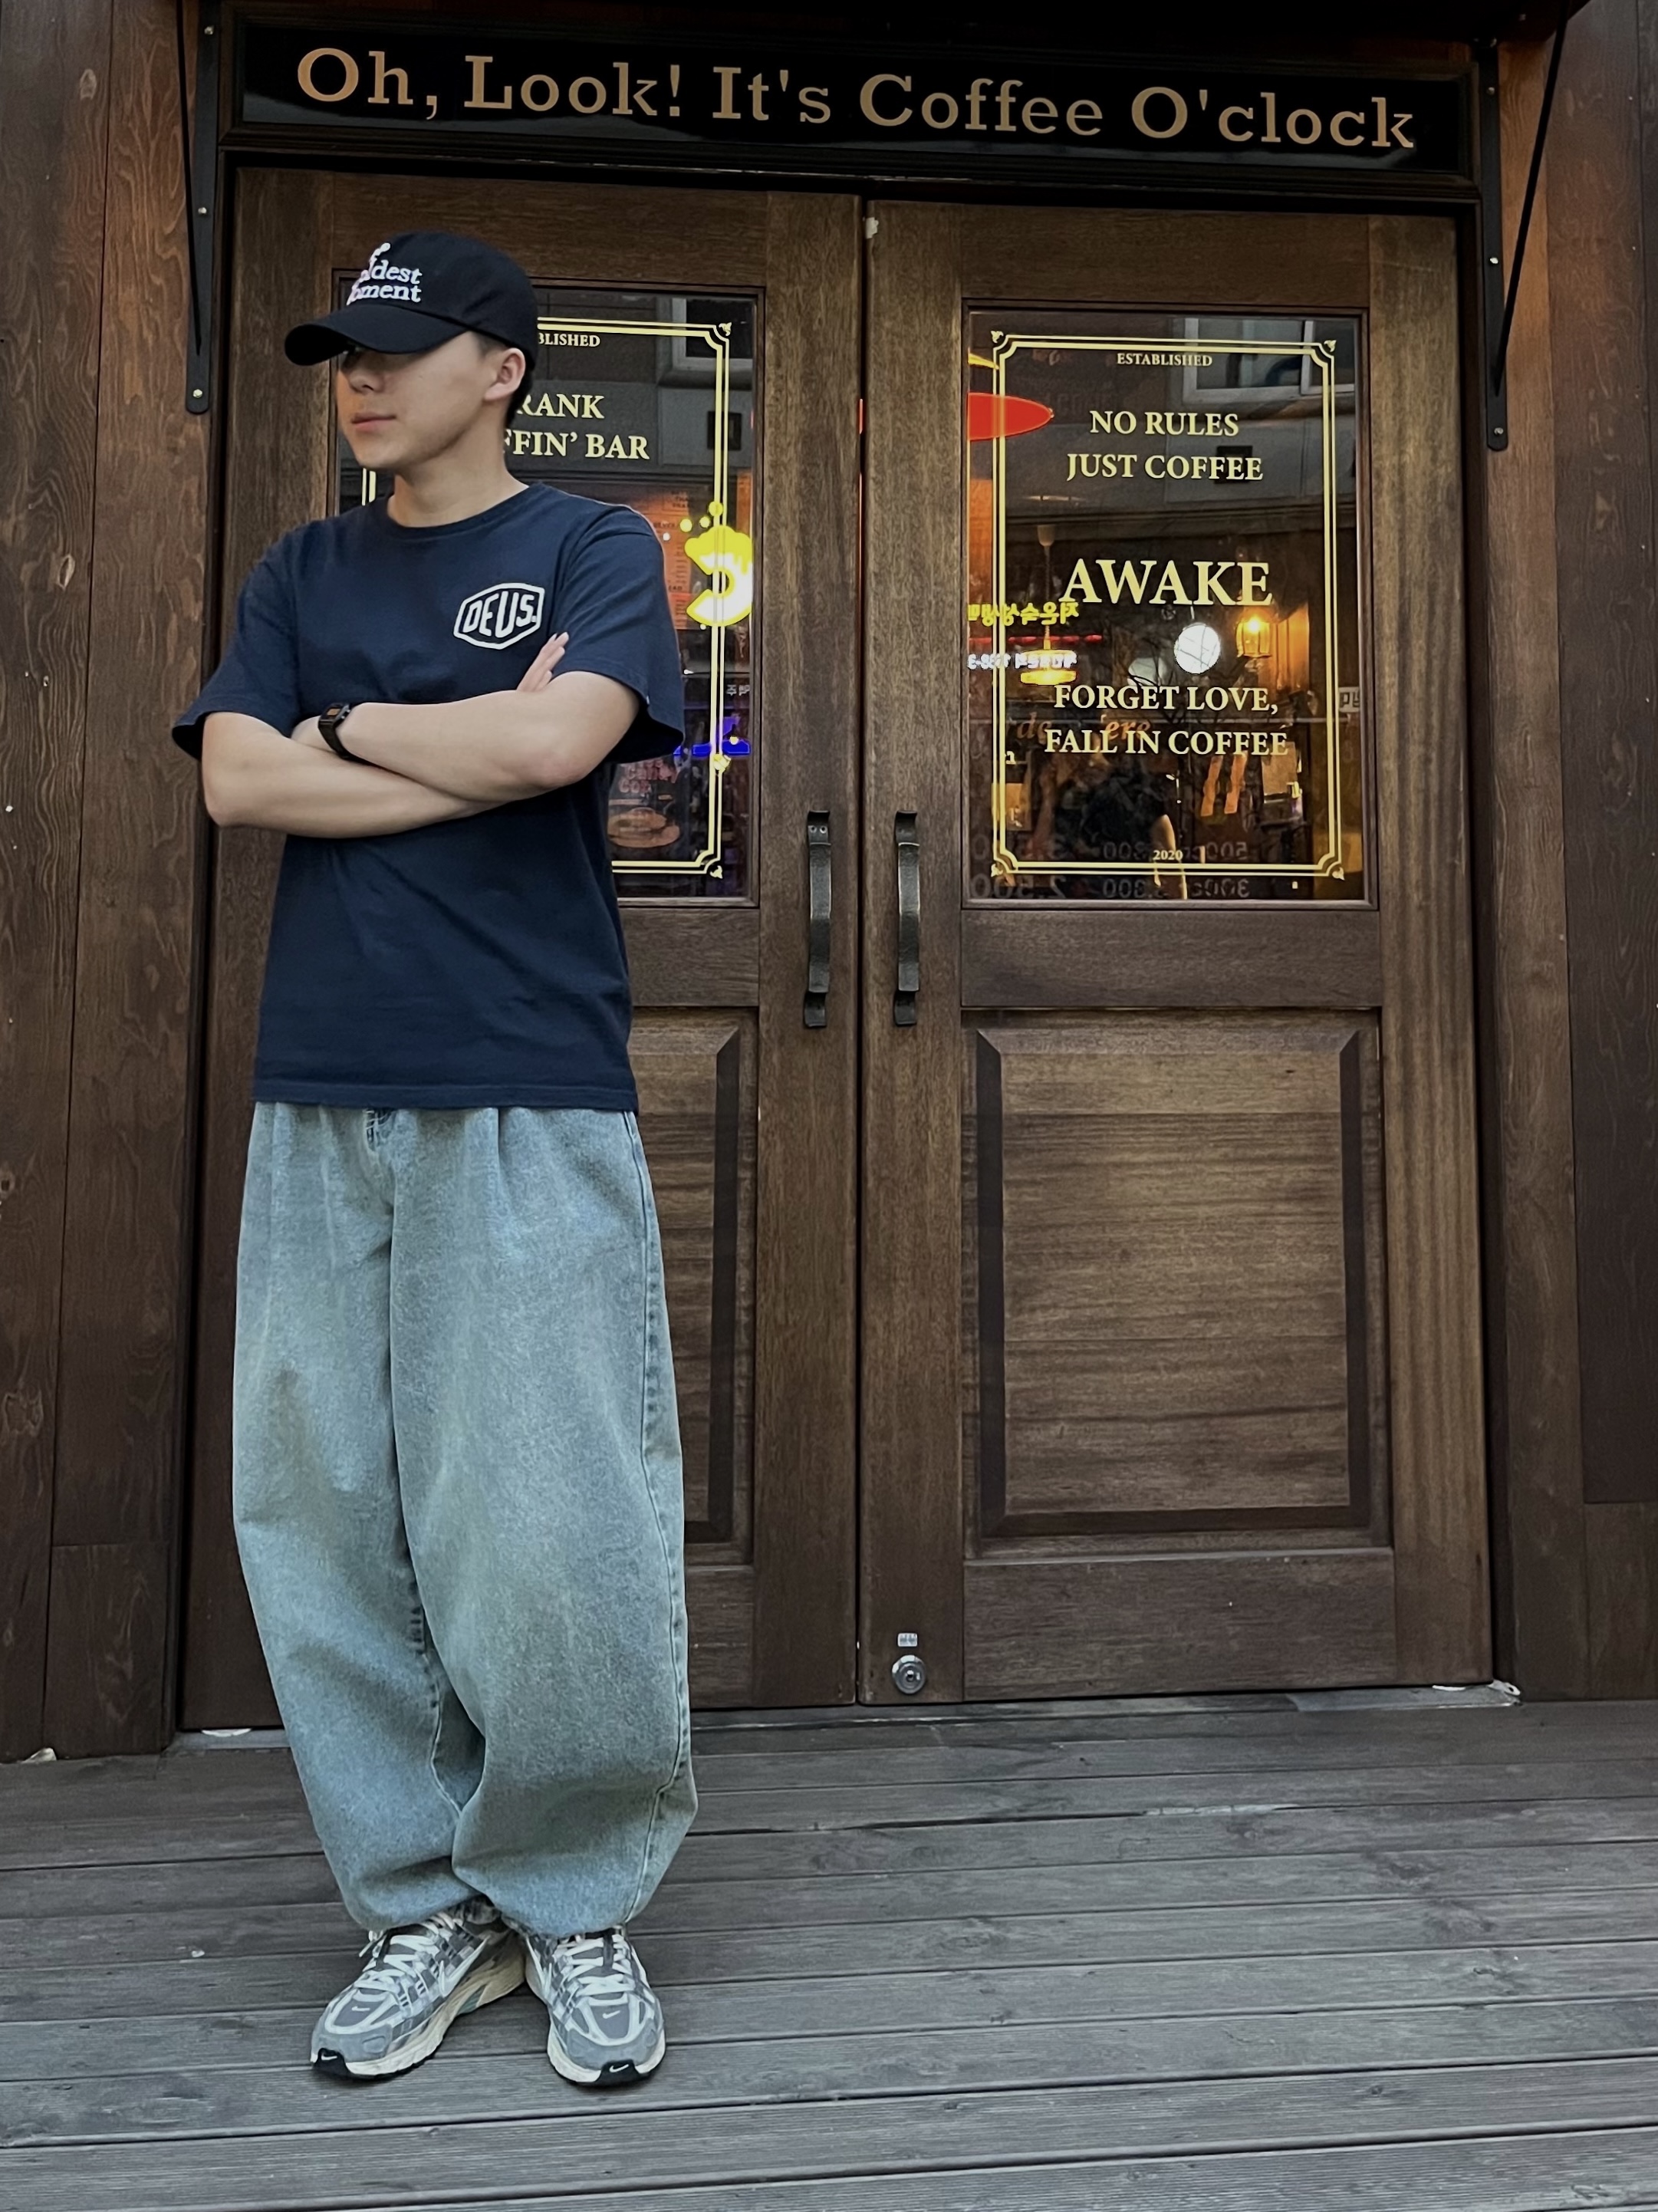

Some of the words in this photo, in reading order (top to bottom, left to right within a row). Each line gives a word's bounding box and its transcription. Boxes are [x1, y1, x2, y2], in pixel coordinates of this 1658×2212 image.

[297, 48, 437, 120] Oh,
[464, 55, 680, 117] Look!
[712, 67, 831, 123] It's
[860, 74, 1103, 136] Coffee
[1131, 87, 1414, 148] O'clock
[1117, 354, 1212, 367] ESTABLISHED
[1090, 410, 1137, 435] NO
[1144, 412, 1239, 436] RULES
[585, 433, 650, 459] BAR
[1067, 453, 1137, 482] JUST
[1144, 455, 1264, 481] COFFEE
[1058, 558, 1272, 606] AWAKE
[1053, 685, 1179, 710] FORGET
[1186, 686, 1279, 715] LOVE,
[1044, 729, 1118, 753] FALL
[1124, 729, 1161, 755] IN
[1168, 731, 1289, 756] COFFEE
[1153, 849, 1183, 861] 2020
